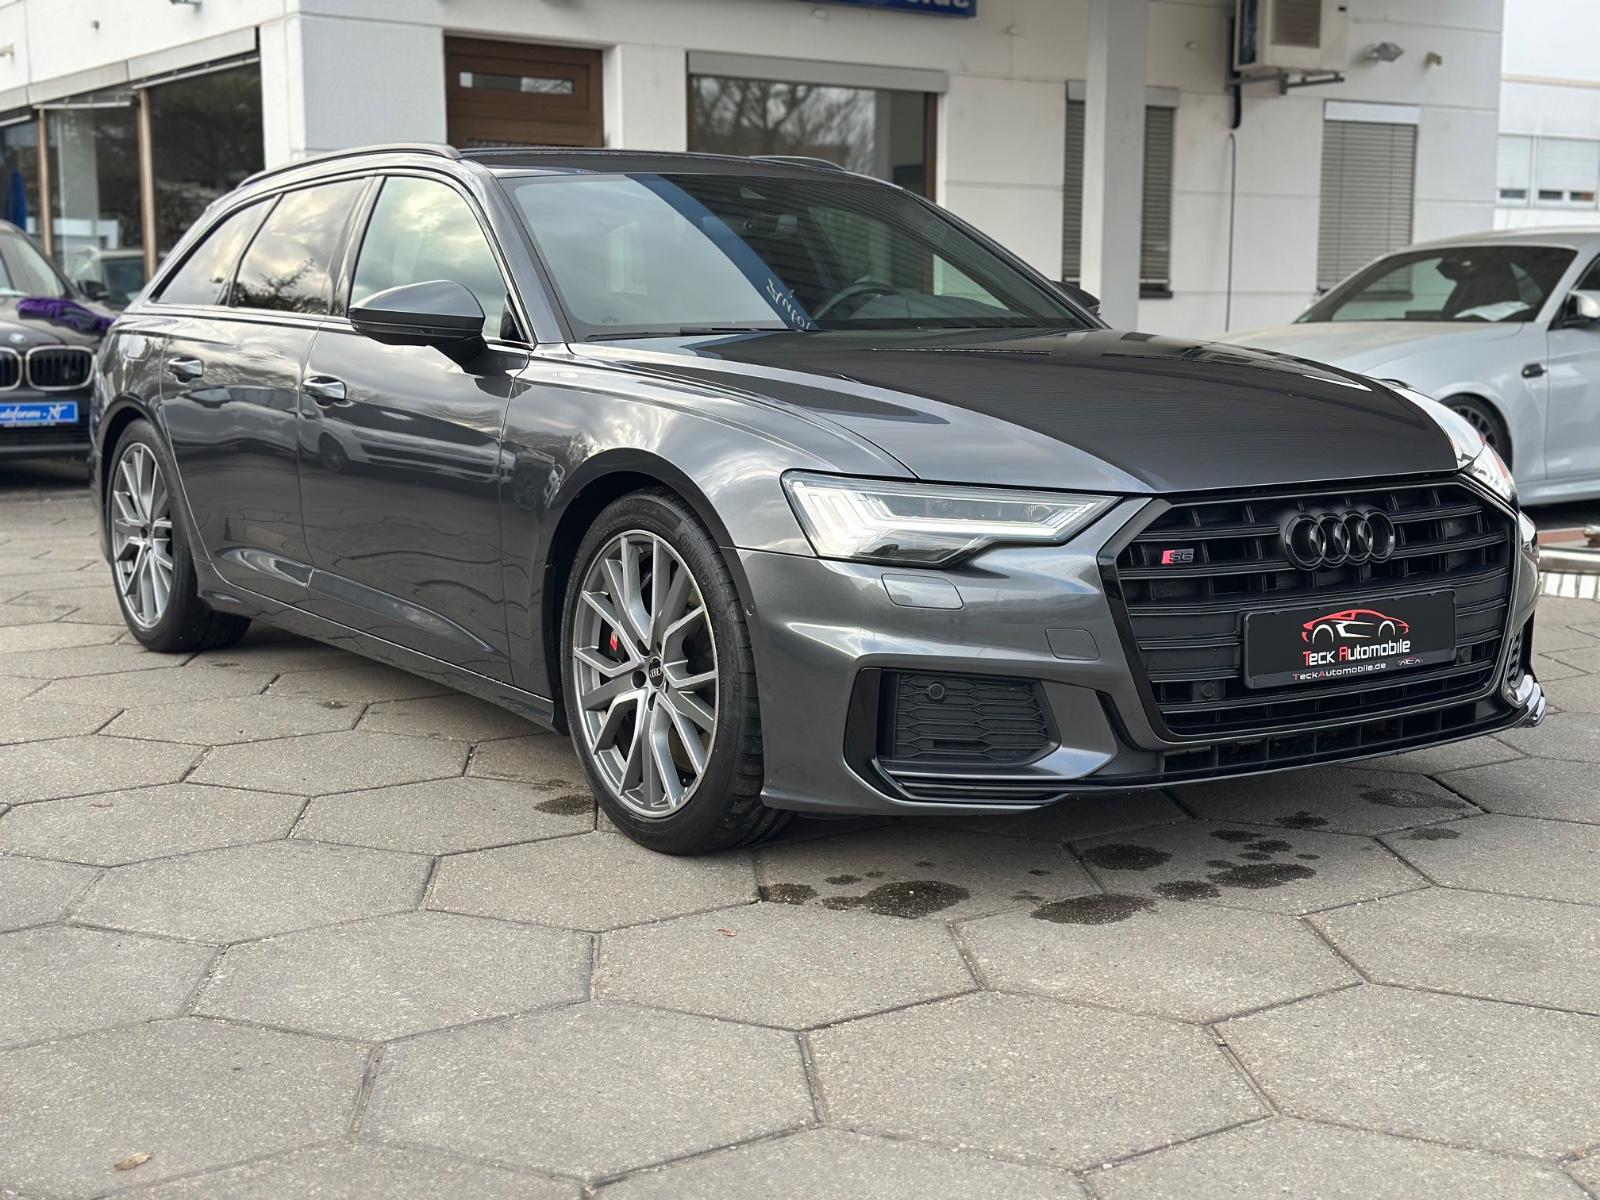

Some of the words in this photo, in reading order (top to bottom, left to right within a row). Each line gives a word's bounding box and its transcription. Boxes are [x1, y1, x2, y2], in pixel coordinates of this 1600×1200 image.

[1169, 551, 1194, 563] S6
[1302, 649, 1335, 666] Teck
[1338, 638, 1411, 662] Automobile
[1292, 662, 1387, 681] TeckAutomobile.de
